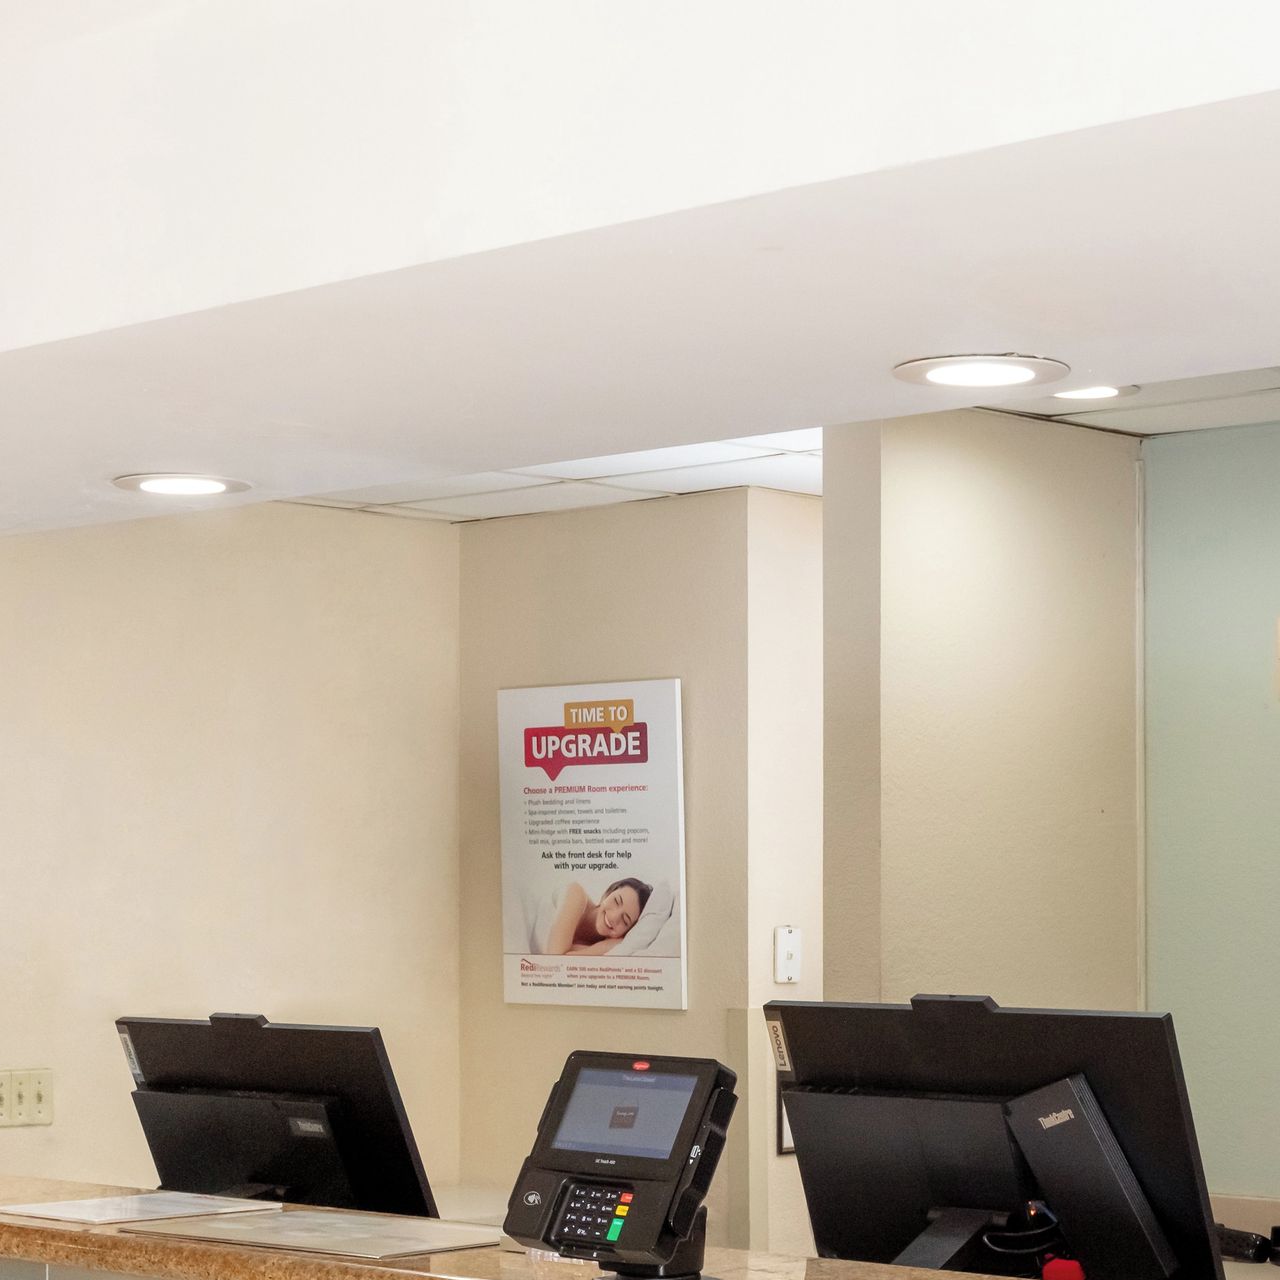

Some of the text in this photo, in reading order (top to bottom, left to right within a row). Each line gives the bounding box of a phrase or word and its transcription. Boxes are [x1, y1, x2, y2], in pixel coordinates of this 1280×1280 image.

[570, 705, 628, 723] TIME TO
[531, 731, 641, 760] UPGRADE
[524, 786, 547, 795] Choose
[554, 785, 586, 794] PREMIUM
[587, 785, 607, 793] Room
[542, 850, 632, 860] Ask the front desk for help
[554, 862, 569, 870] with
[571, 863, 587, 871] your
[772, 1025, 787, 1067] Lenovo
